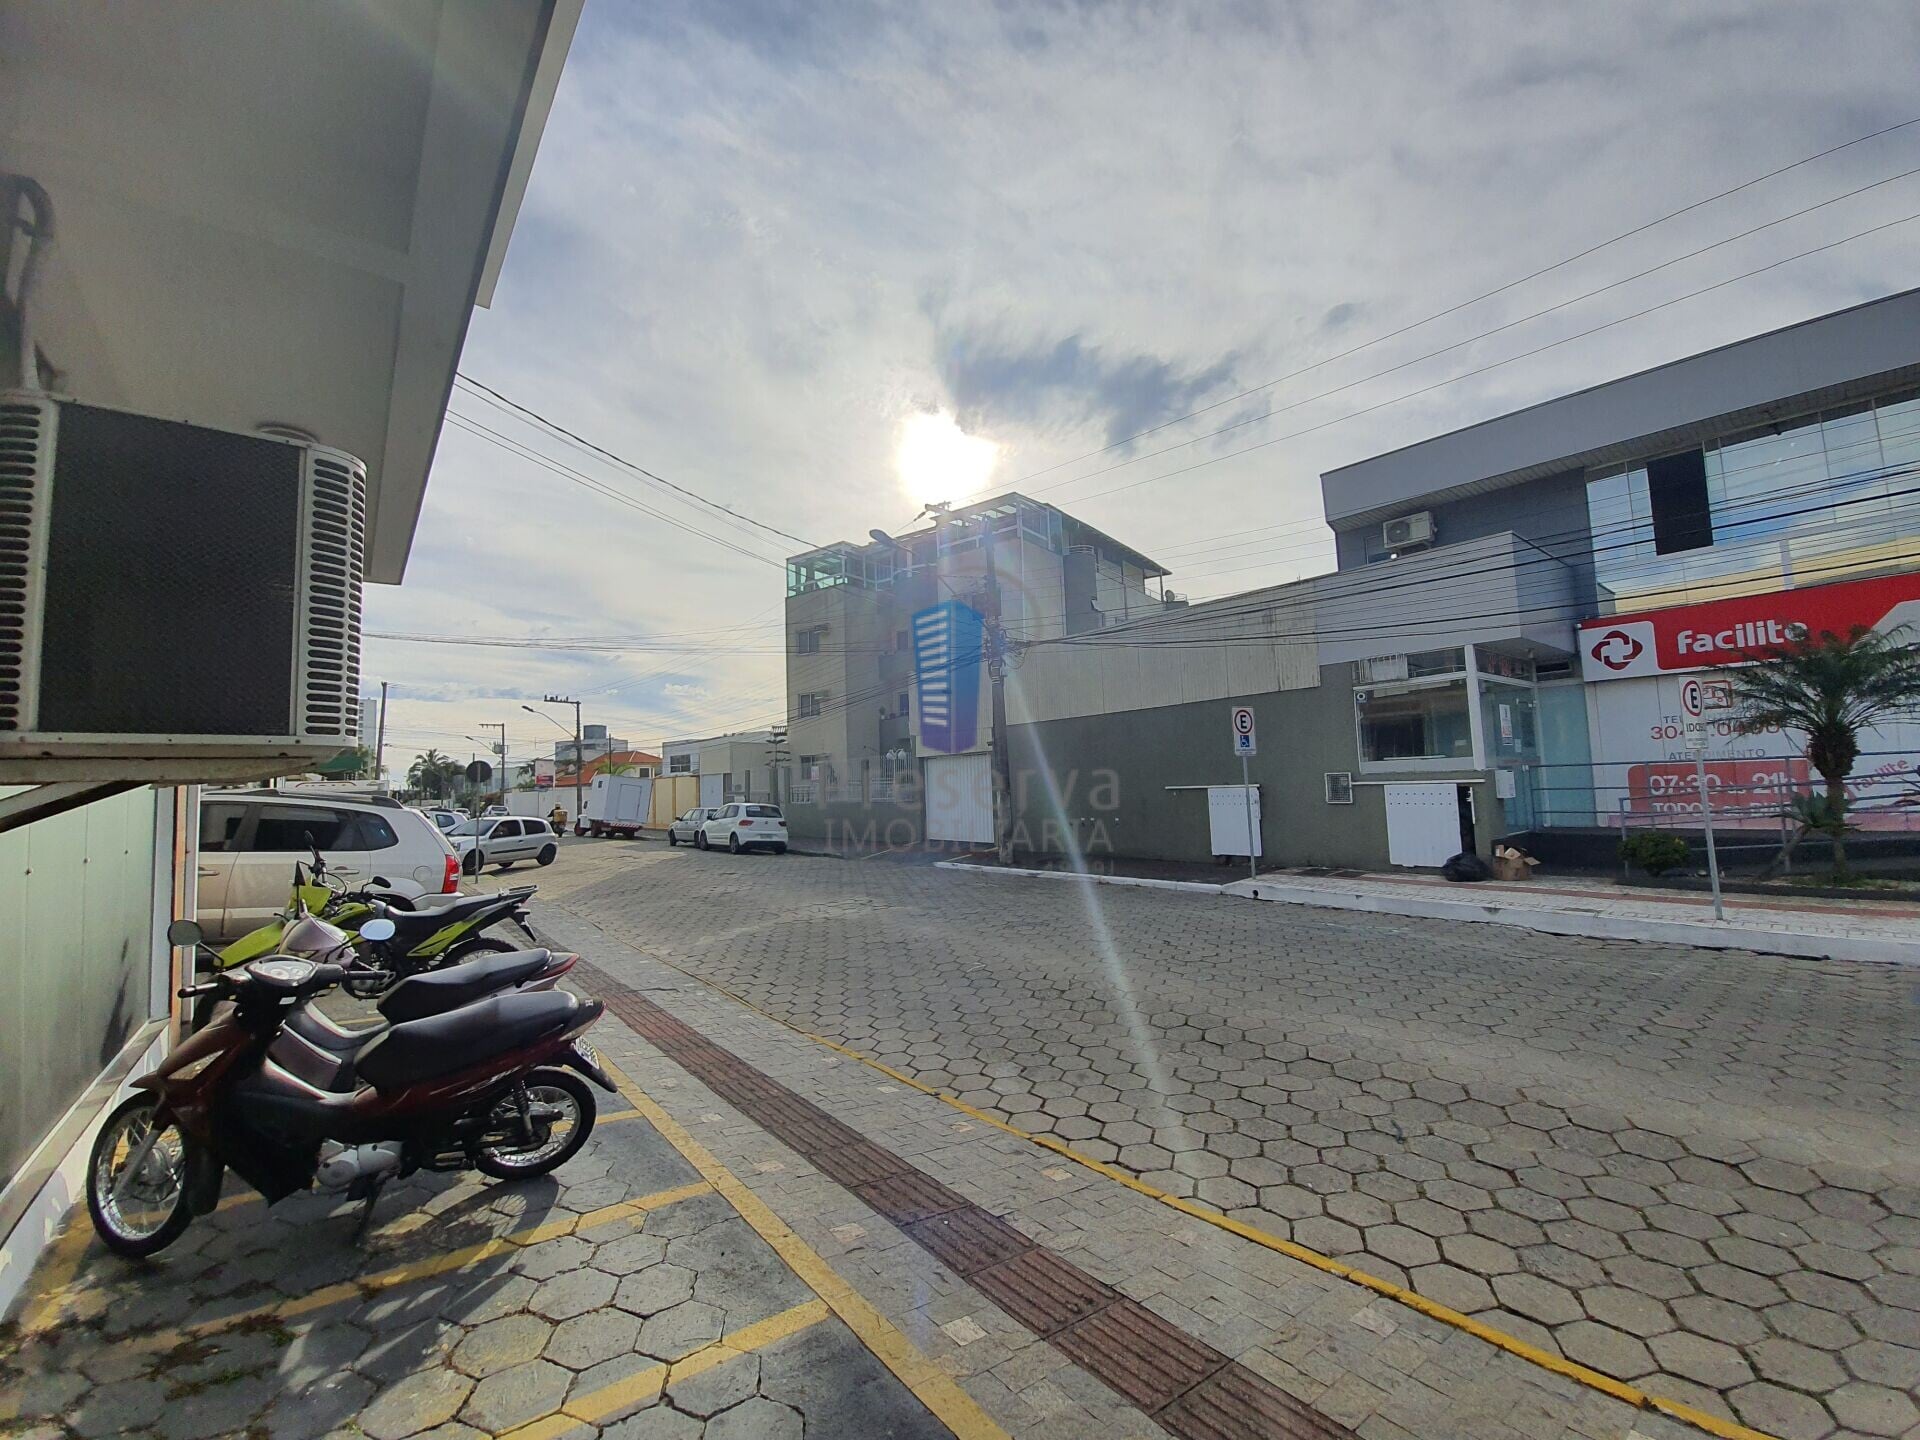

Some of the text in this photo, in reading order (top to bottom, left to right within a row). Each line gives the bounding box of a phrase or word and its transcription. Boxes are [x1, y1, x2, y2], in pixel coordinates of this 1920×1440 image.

[1690, 687, 1699, 709] E
[1239, 714, 1248, 729] E
[1668, 748, 1767, 761] ATEDIMENTO
